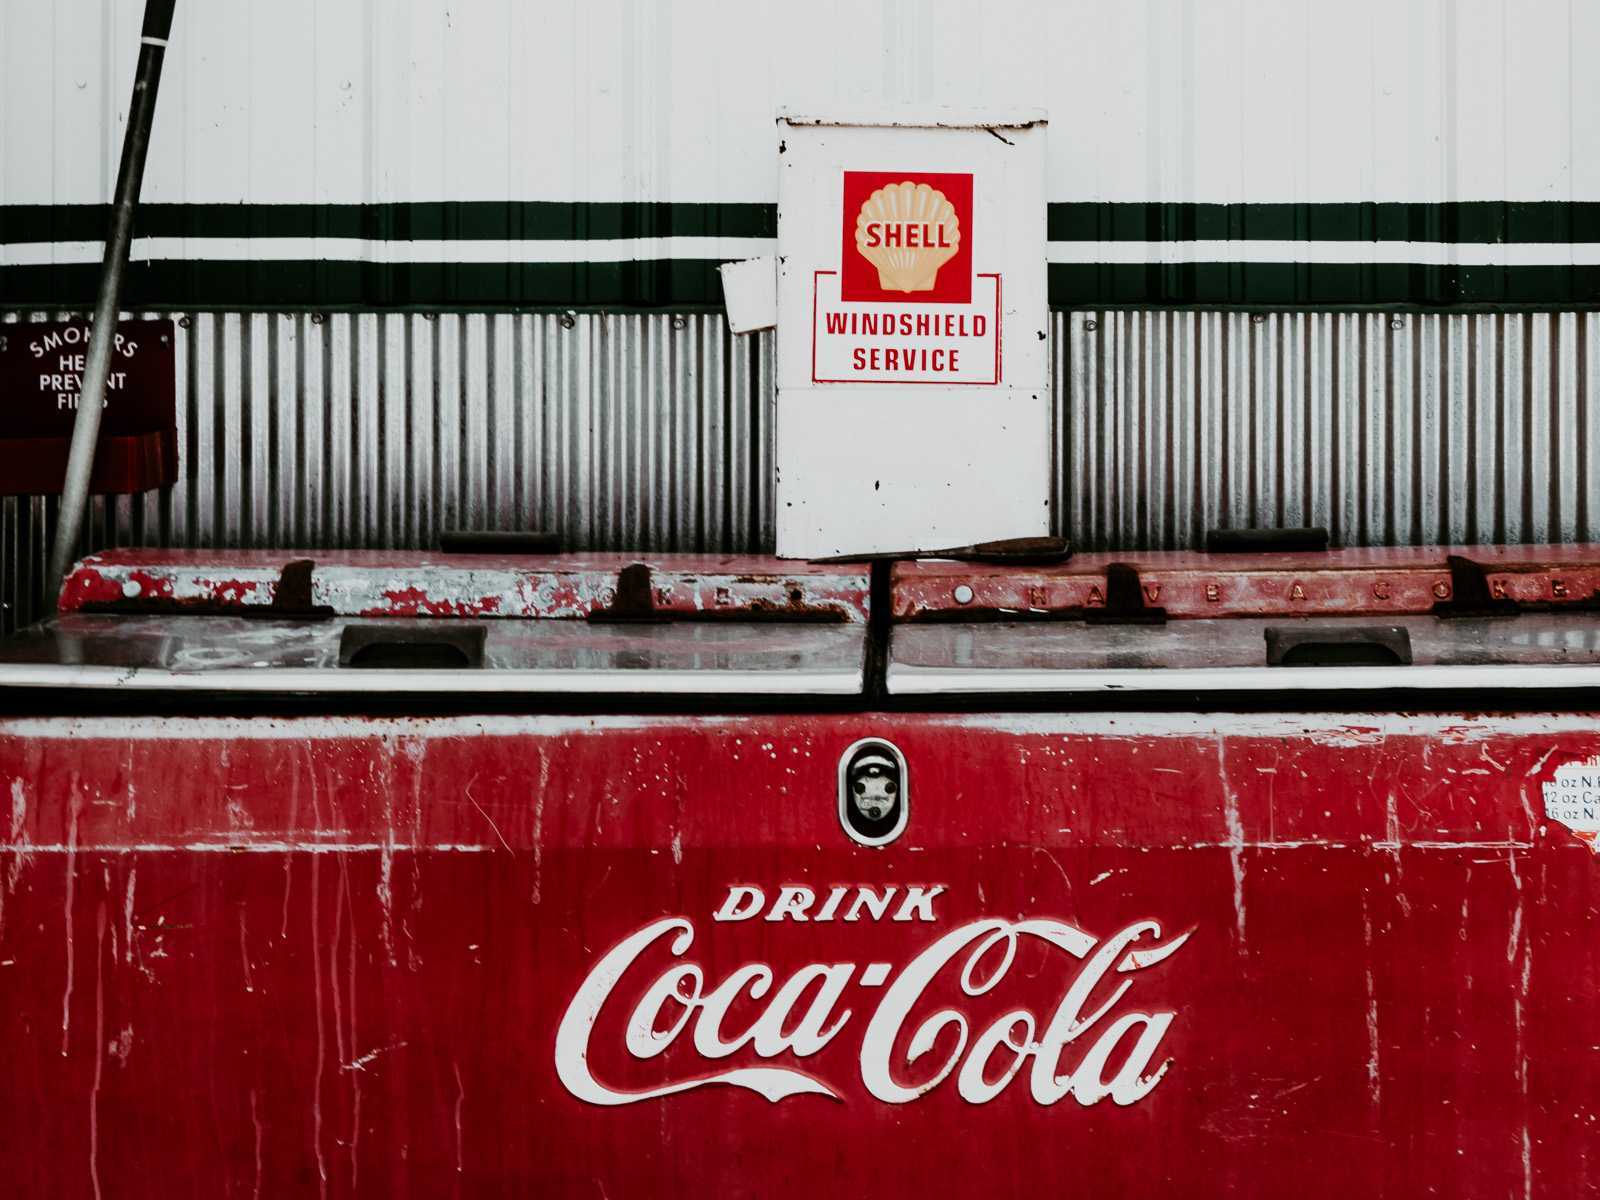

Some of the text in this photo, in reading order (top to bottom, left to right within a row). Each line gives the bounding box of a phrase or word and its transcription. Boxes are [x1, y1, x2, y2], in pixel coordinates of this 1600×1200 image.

[866, 223, 950, 247] SHELL
[827, 313, 986, 337] WINDSHIELD
[30, 327, 138, 358] SMORS
[853, 348, 959, 371] SERVICE
[39, 373, 126, 391] PREVNT
[1029, 579, 1567, 605] HAVE A COKE
[1561, 779, 1577, 788] oz
[1562, 794, 1577, 804] oz
[1563, 810, 1578, 820] oz
[713, 885, 948, 922] DRINK
[555, 917, 1199, 1106] Coca-Cola
